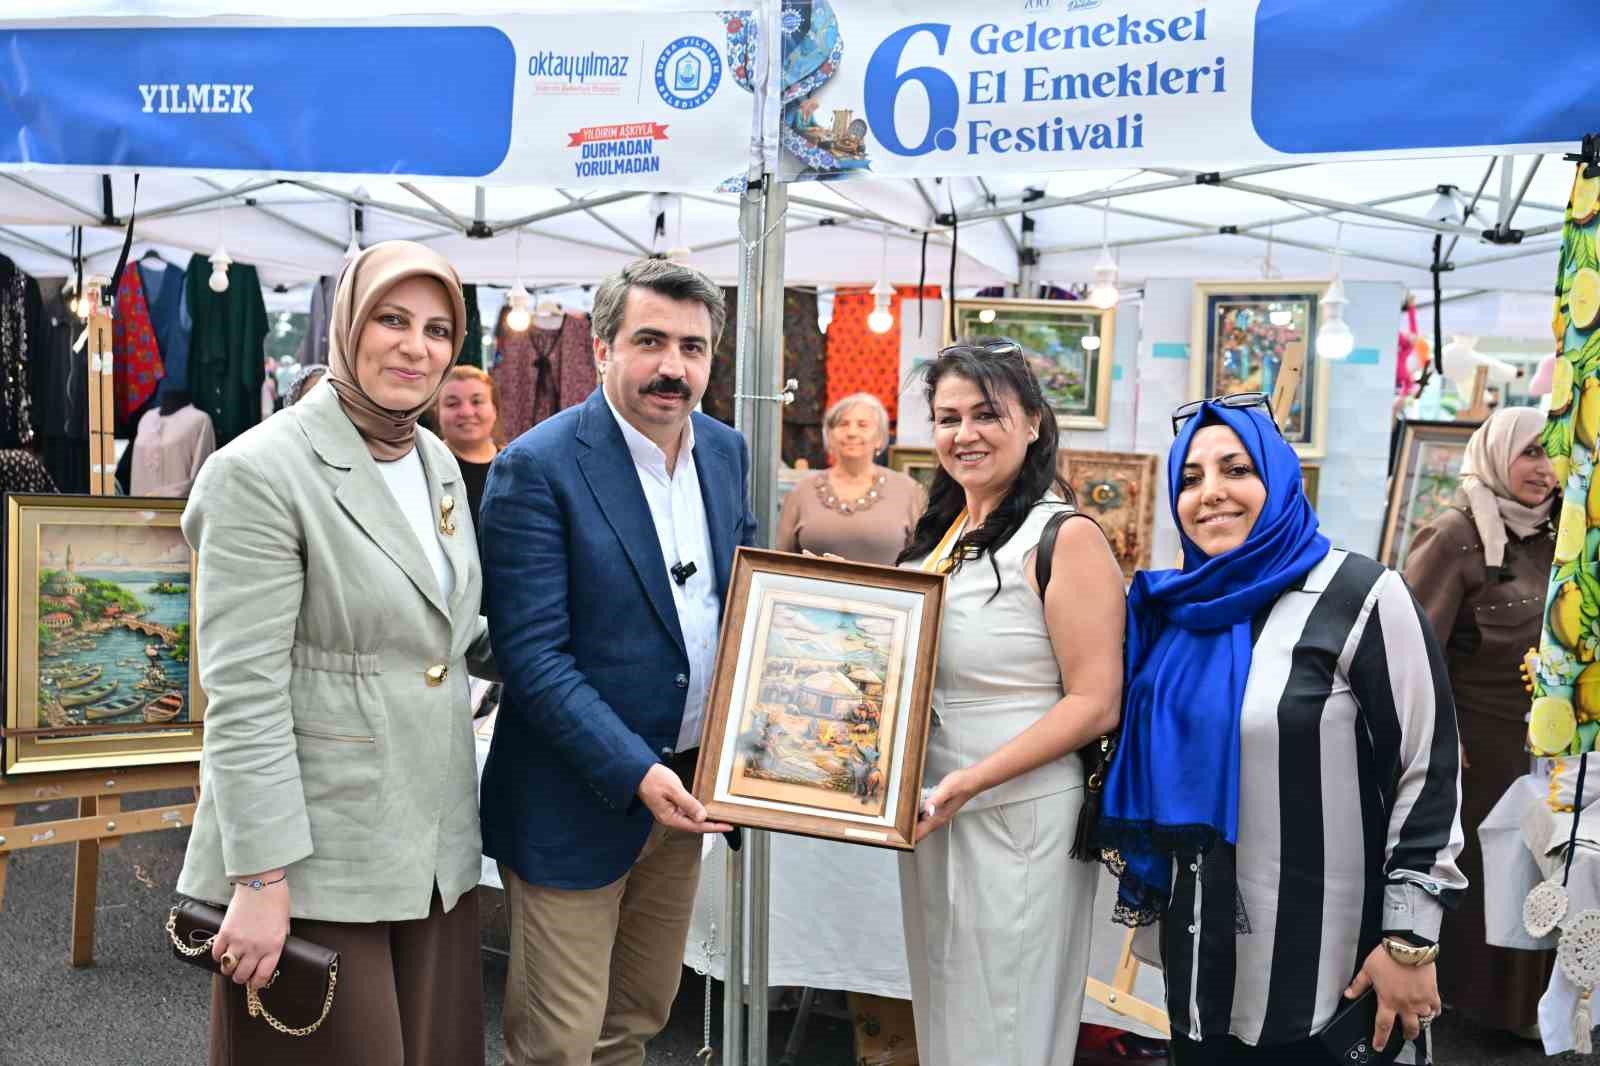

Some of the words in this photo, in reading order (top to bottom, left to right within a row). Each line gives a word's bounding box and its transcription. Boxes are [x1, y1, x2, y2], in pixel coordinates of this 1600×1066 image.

[970, 8, 1207, 55] Geleneksel
[967, 70, 1007, 104] El
[1022, 56, 1228, 103] Emekleri
[138, 84, 255, 114] YILMEK
[582, 138, 653, 159] DURMADAN
[583, 126, 618, 141] YILDIRIM
[967, 113, 1144, 155] Festivali
[575, 156, 660, 178] YORULMADAN
